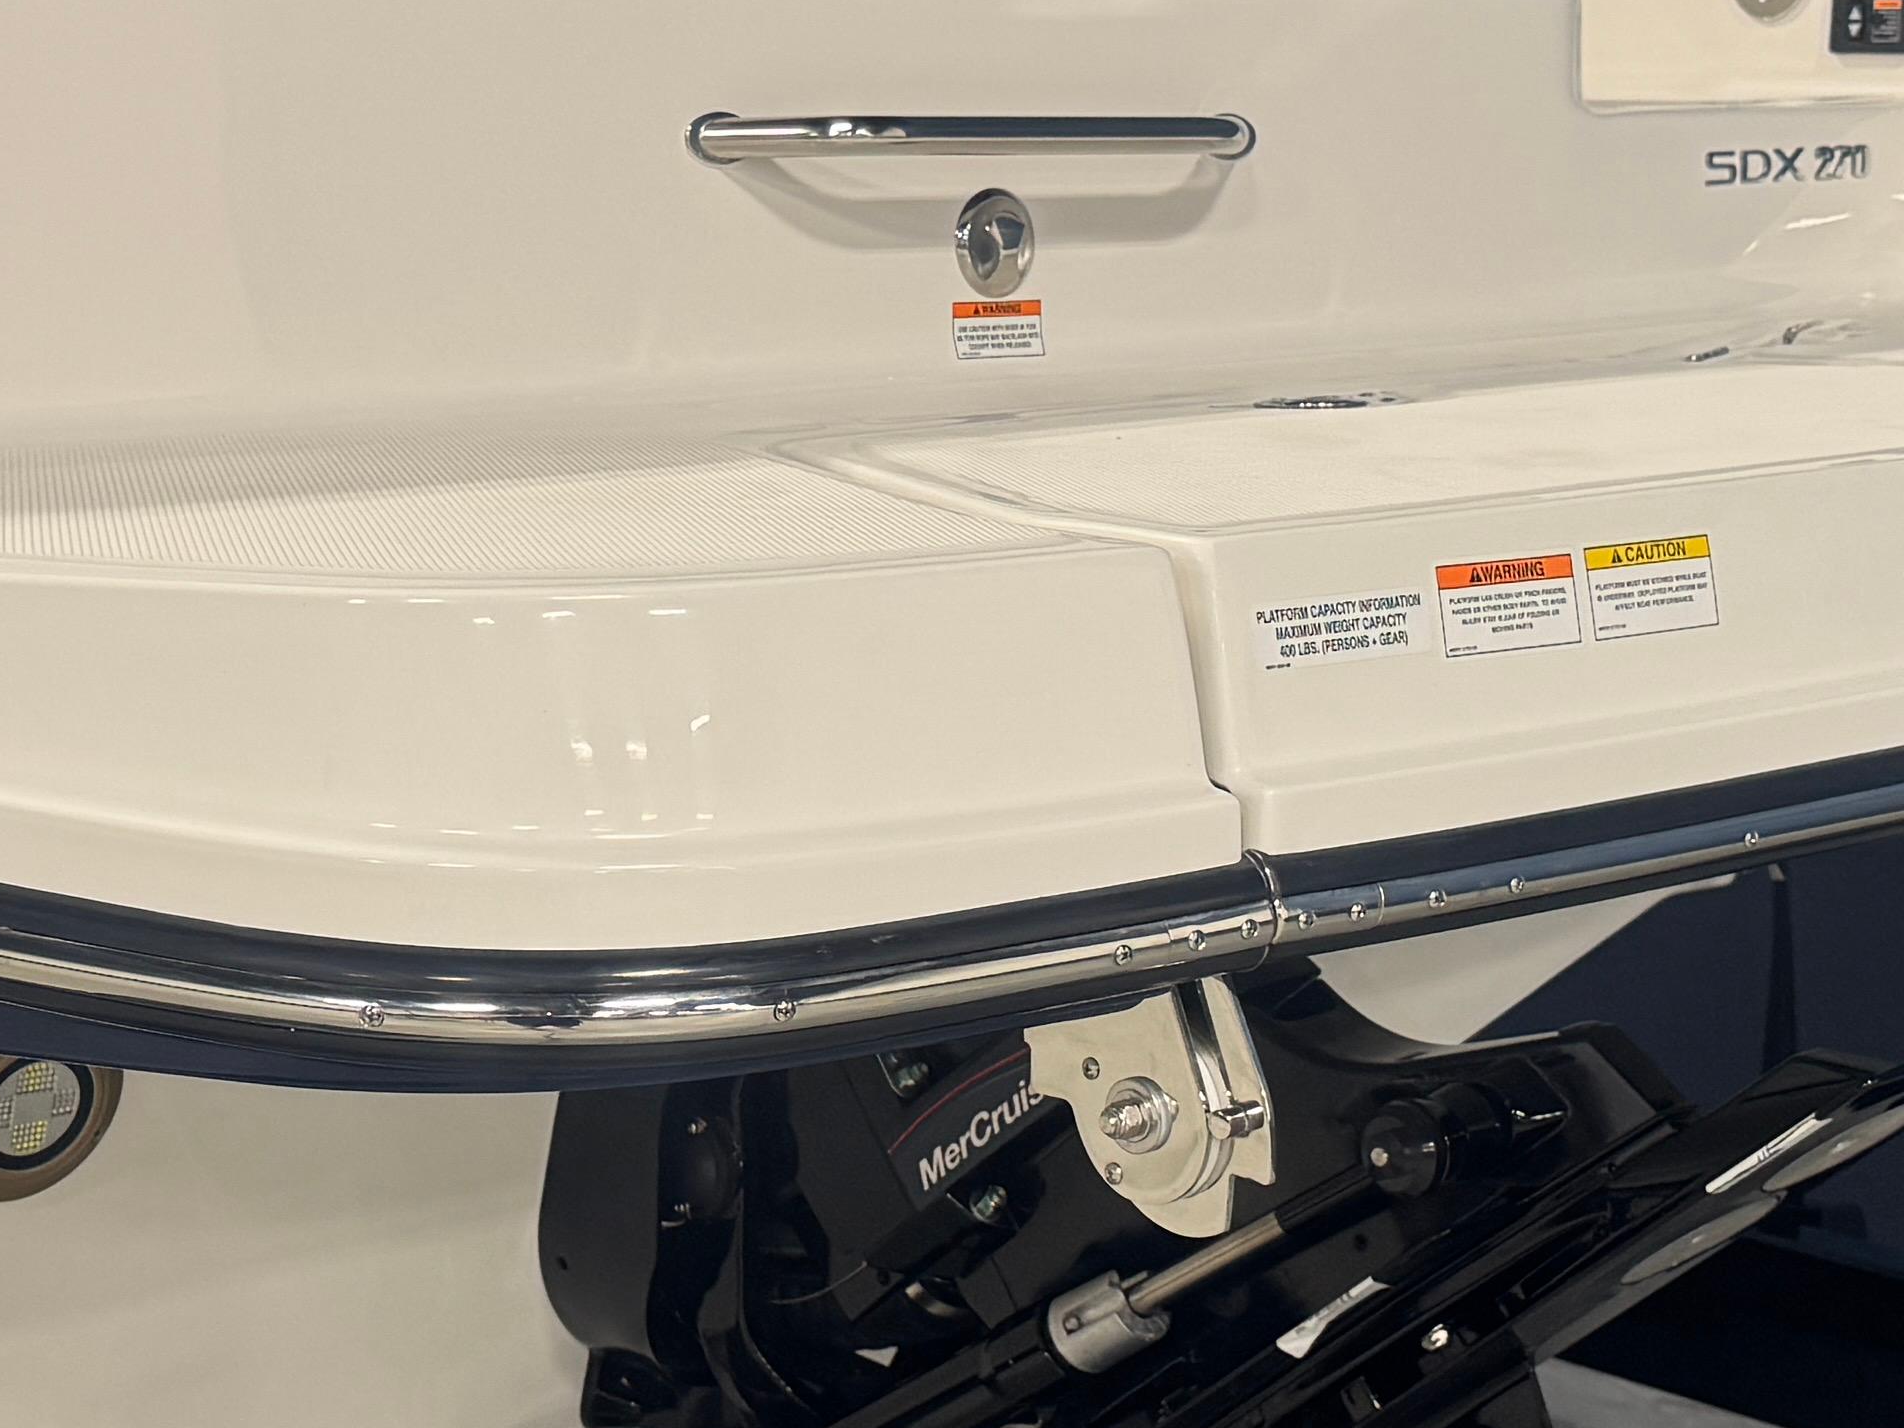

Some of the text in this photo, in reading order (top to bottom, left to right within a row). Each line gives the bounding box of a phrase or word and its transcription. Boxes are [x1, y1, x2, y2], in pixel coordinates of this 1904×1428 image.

[1704, 147, 1804, 187] SDX
[1624, 540, 1687, 563] CAUTION
[1480, 560, 1545, 583] WARNING
[1256, 593, 1421, 624] PLATFORM CAPACITY INFORMATION
[1275, 612, 1408, 641] MAXIMUM WEIGHT CAPACITY
[1280, 643, 1296, 658] 400
[1298, 641, 1320, 657] LBS.
[1322, 635, 1370, 655] (PERSONS
[1379, 630, 1409, 647] GEAR)
